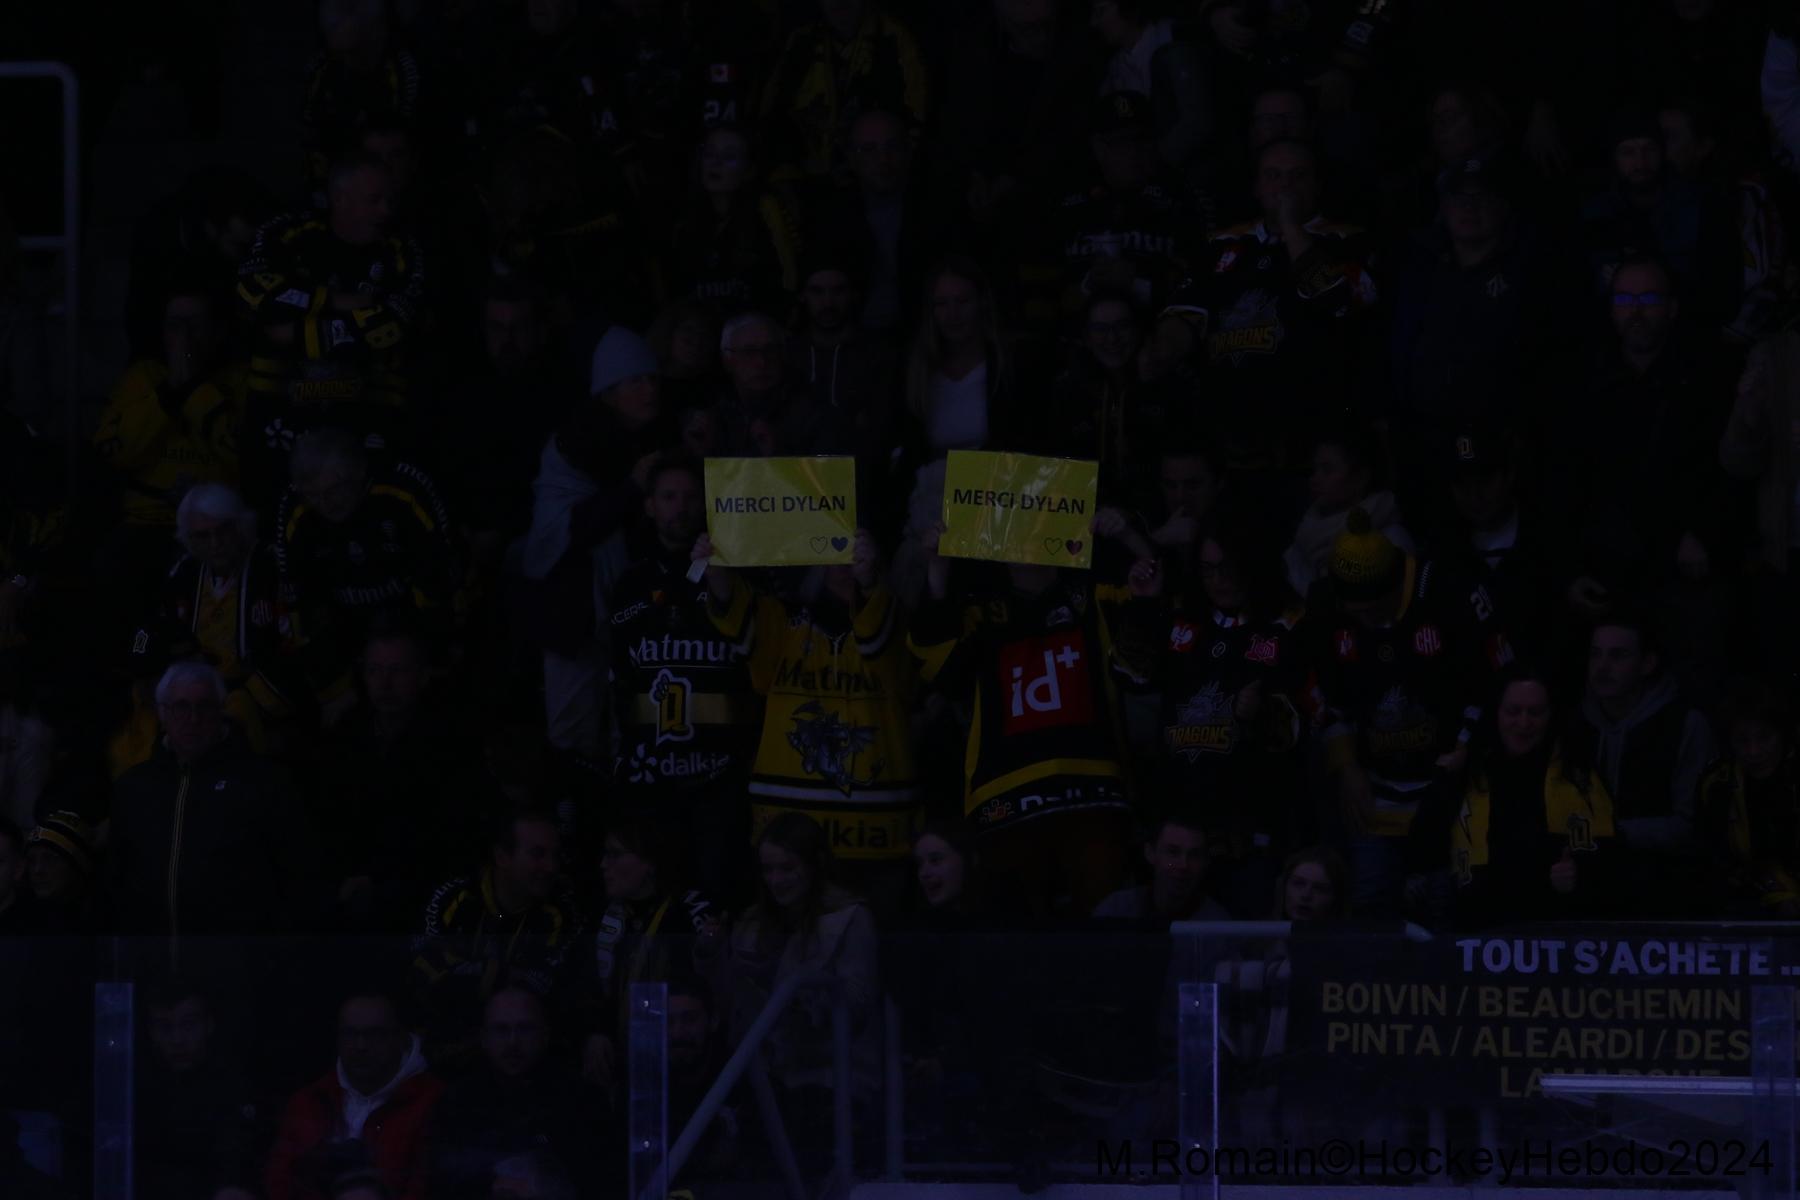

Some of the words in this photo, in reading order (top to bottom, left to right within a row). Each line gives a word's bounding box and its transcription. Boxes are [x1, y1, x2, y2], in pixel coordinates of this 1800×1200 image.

[715, 497, 776, 513] MERCI
[783, 495, 846, 512] DYLAN
[953, 488, 1014, 507] MERCI
[1021, 491, 1085, 515] DYLAN
[774, 656, 882, 692] Matmu
[1166, 725, 1233, 748] DRAGONS
[1456, 938, 1566, 973] TOUT
[1321, 981, 1447, 1016] BOIVIN
[1478, 984, 1742, 1021] BEAUCHEMIN
[1327, 1022, 1441, 1056] PINTA
[1472, 1025, 1645, 1059] ALEARDI
